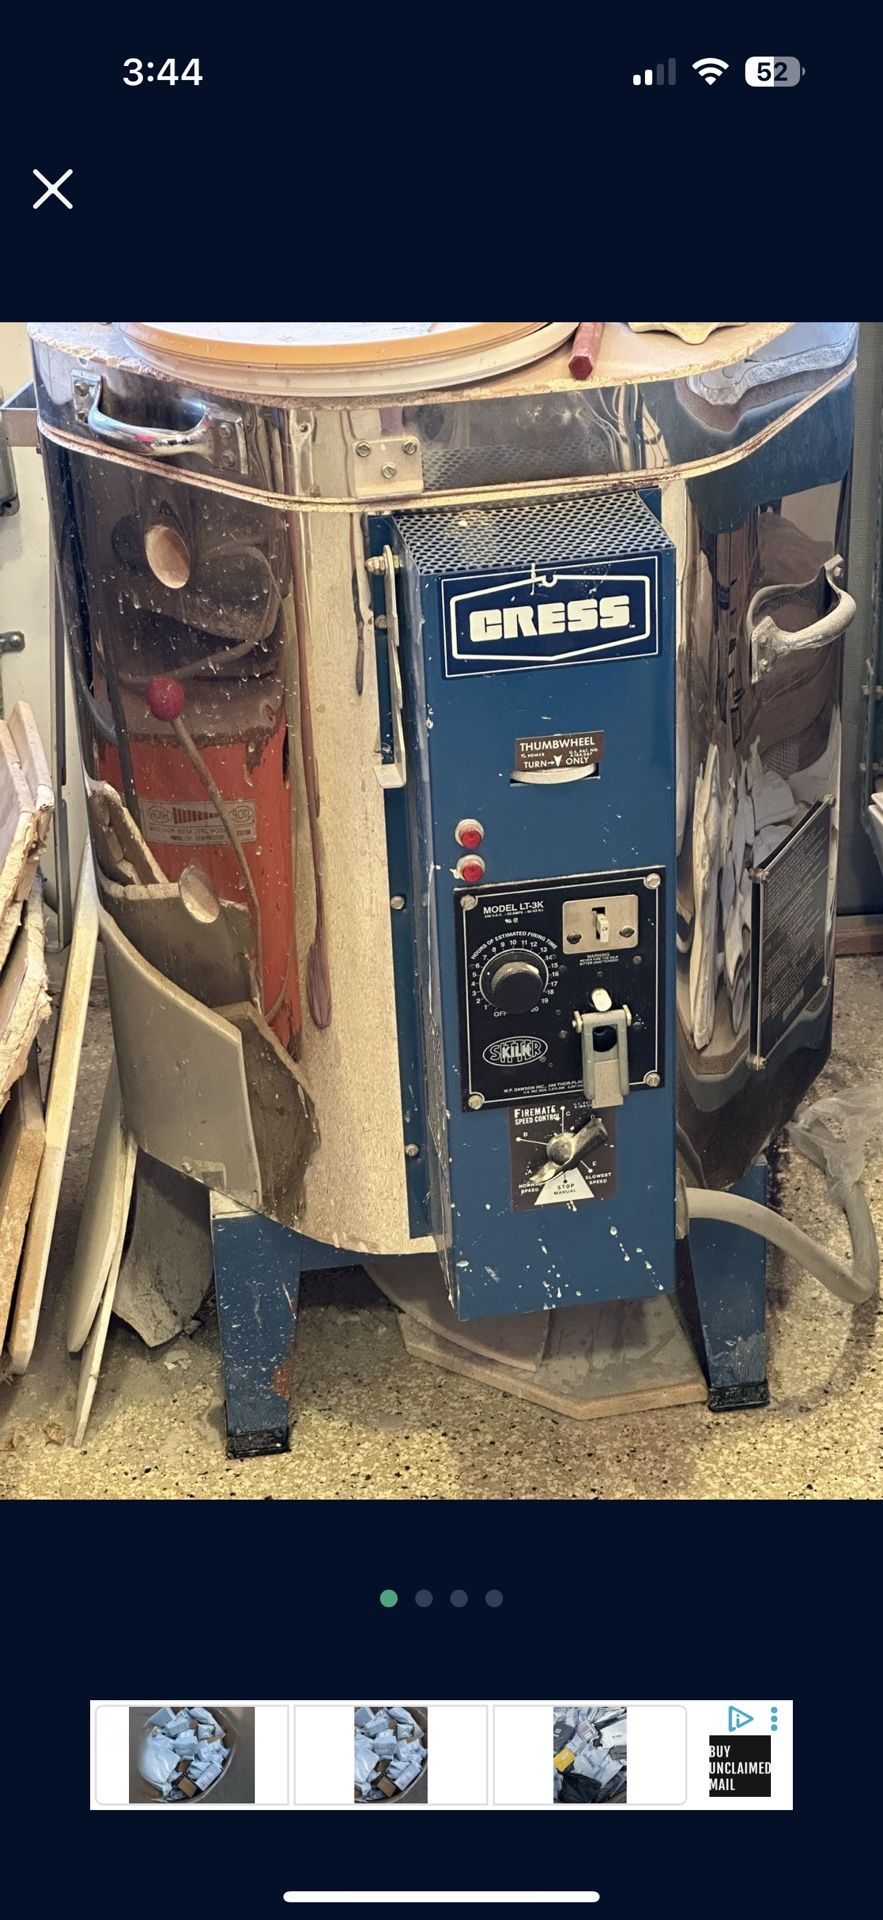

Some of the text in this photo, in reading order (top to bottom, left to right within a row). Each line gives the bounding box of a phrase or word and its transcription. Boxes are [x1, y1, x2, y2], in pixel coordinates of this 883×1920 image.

[469, 594, 630, 642] CRESS
[519, 736, 596, 751] THUMBWHEEL
[523, 756, 589, 769] TURN ONLY
[483, 903, 518, 914] MODEL
[519, 900, 545, 911] LT-3K
[471, 943, 488, 960] HOURS
[494, 930, 527, 942] ESTIMATED
[527, 931, 546, 942] FIRING
[546, 938, 558, 950] TIME
[493, 1010, 508, 1018] OFF
[501, 1042, 532, 1059] KILN
[514, 1105, 556, 1119] FIREMATE
[514, 1113, 560, 1126] SPEED CONTROL
[585, 1172, 612, 1180] SLOWEST
[553, 1188, 577, 1196] MANUAL
